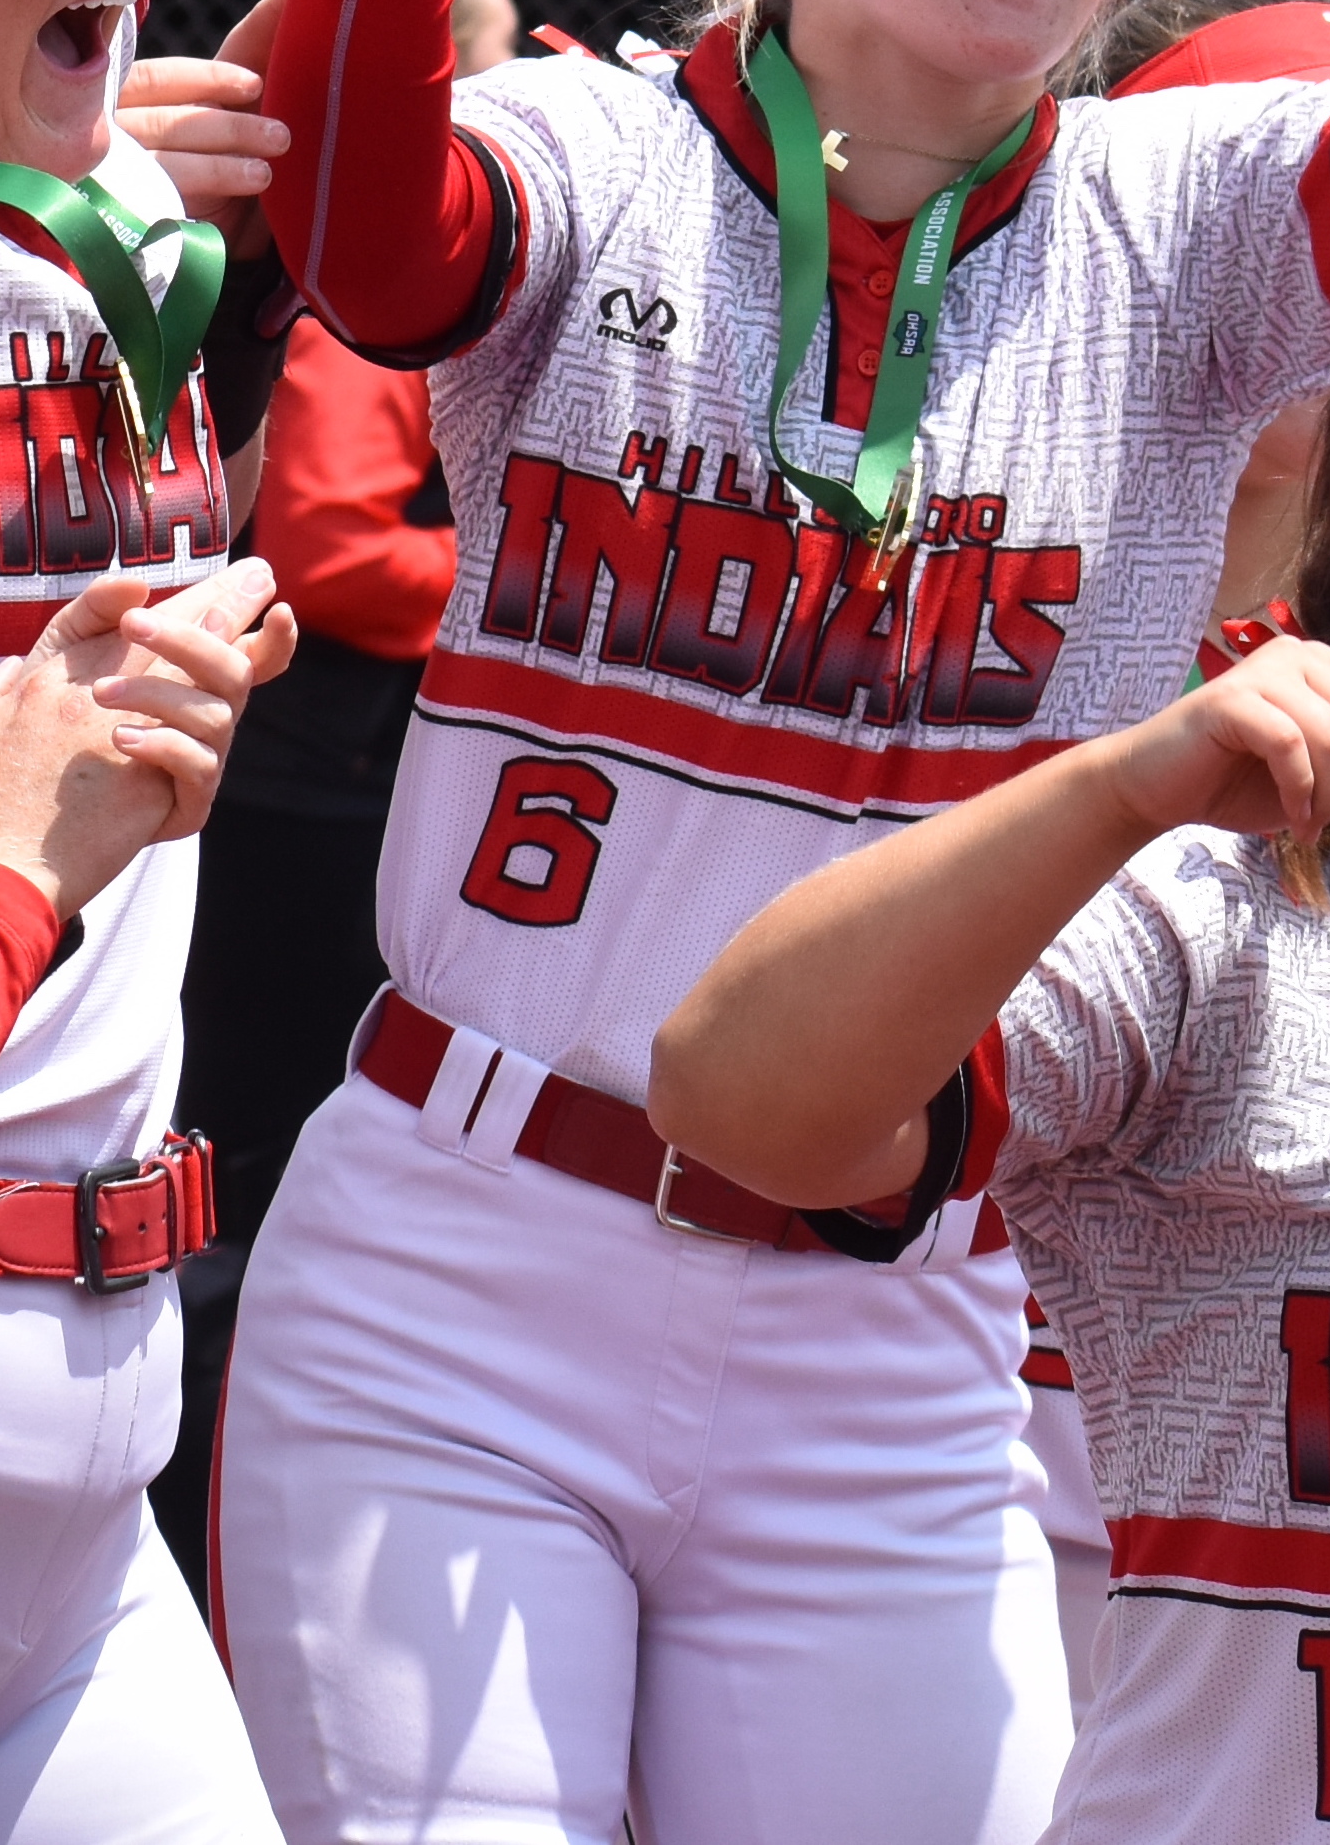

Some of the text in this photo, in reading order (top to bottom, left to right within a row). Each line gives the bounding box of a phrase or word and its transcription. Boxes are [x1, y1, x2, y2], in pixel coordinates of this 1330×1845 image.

[913, 191, 955, 285] ASSOCIATION
[900, 312, 920, 355] OHSAA
[458, 755, 620, 927] 6
